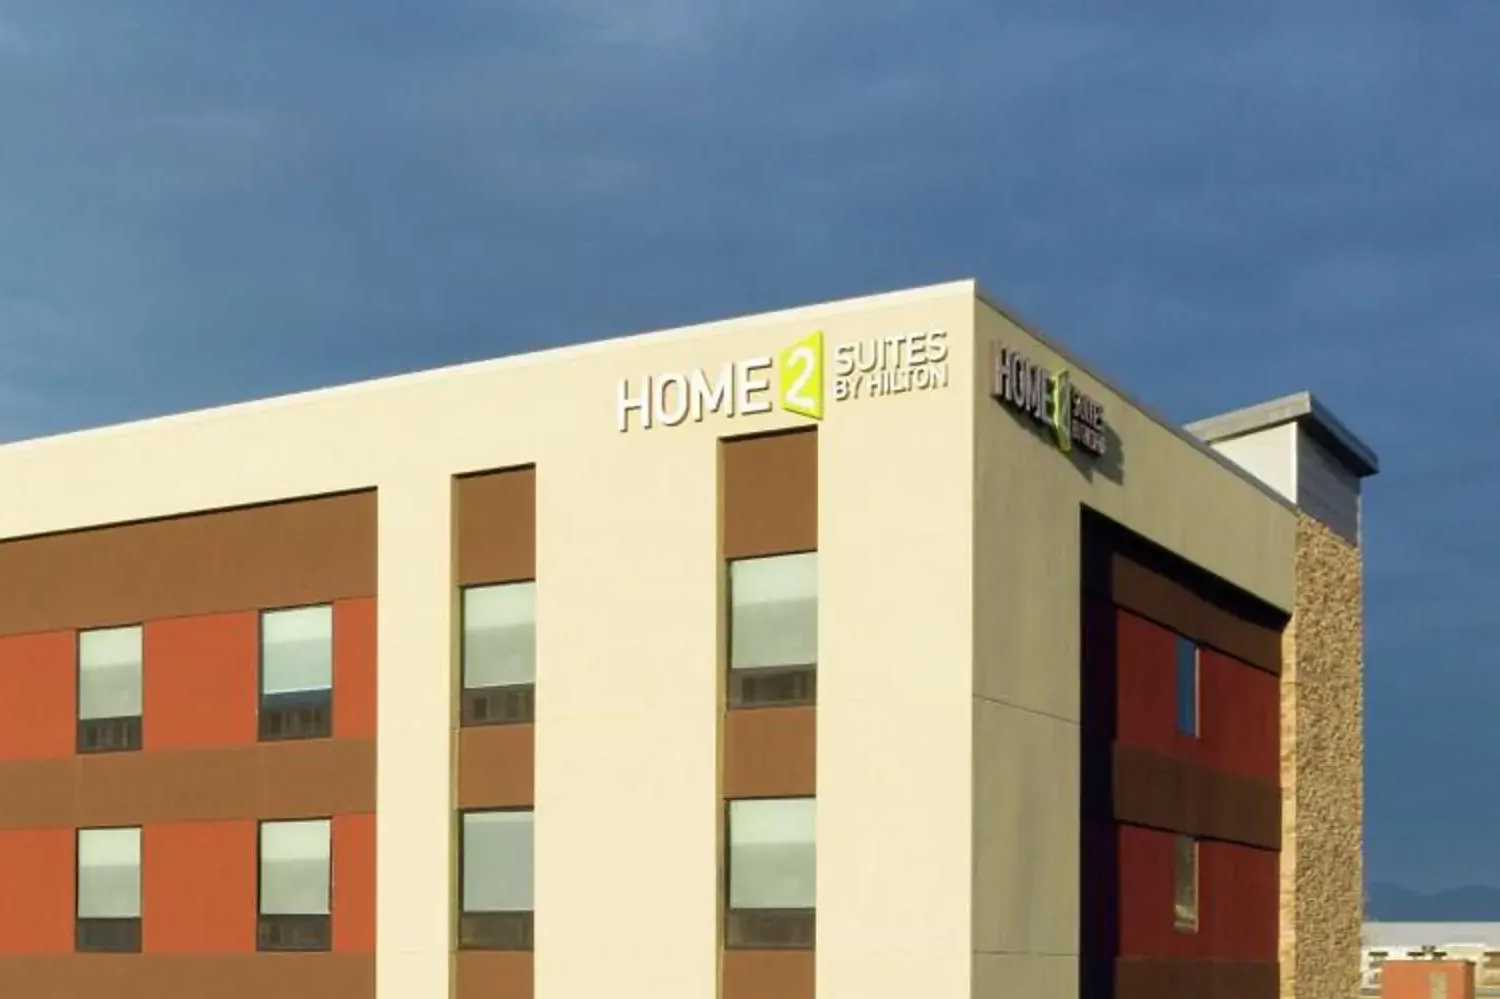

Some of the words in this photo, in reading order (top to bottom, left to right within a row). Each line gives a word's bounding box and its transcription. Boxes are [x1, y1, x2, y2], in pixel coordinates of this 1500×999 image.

[833, 375, 864, 402] BY
[869, 363, 949, 398] HILTON
[834, 331, 949, 377] SUITES
[993, 343, 1054, 426] HOME
[616, 356, 773, 433] HOME
[784, 345, 816, 409] 2
